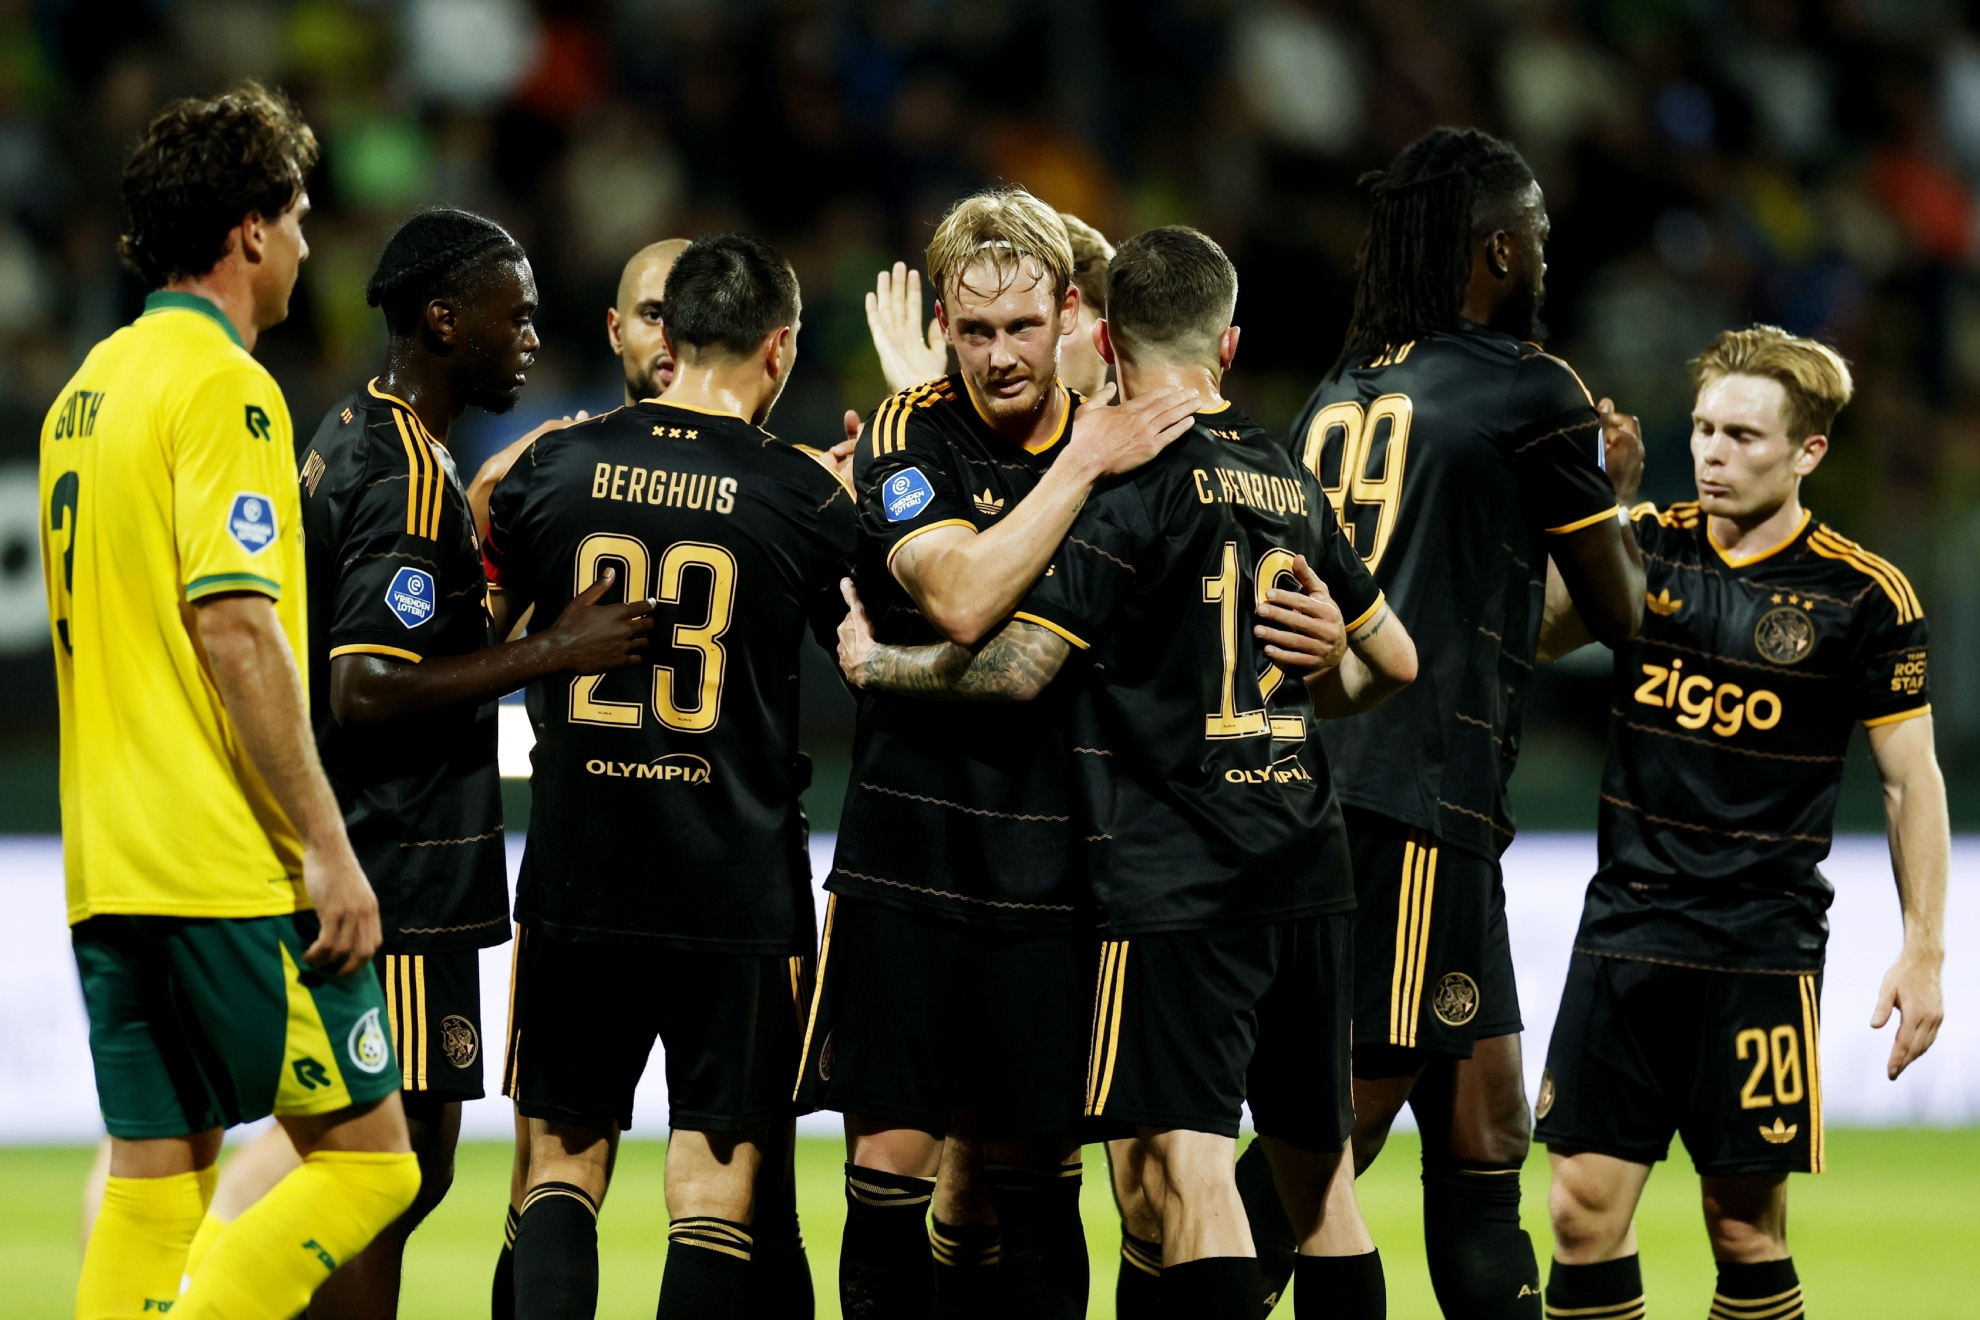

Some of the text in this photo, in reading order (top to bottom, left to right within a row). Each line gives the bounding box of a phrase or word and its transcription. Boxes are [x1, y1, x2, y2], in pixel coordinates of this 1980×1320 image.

[55, 390, 105, 441] GUTH
[591, 462, 738, 515] BERGHUIS
[393, 593, 431, 612] VRIENDEN
[568, 531, 738, 734] 23
[1634, 658, 1782, 737] ziggo
[586, 754, 711, 786] OLYMPIA
[1735, 1024, 1804, 1109] 20
